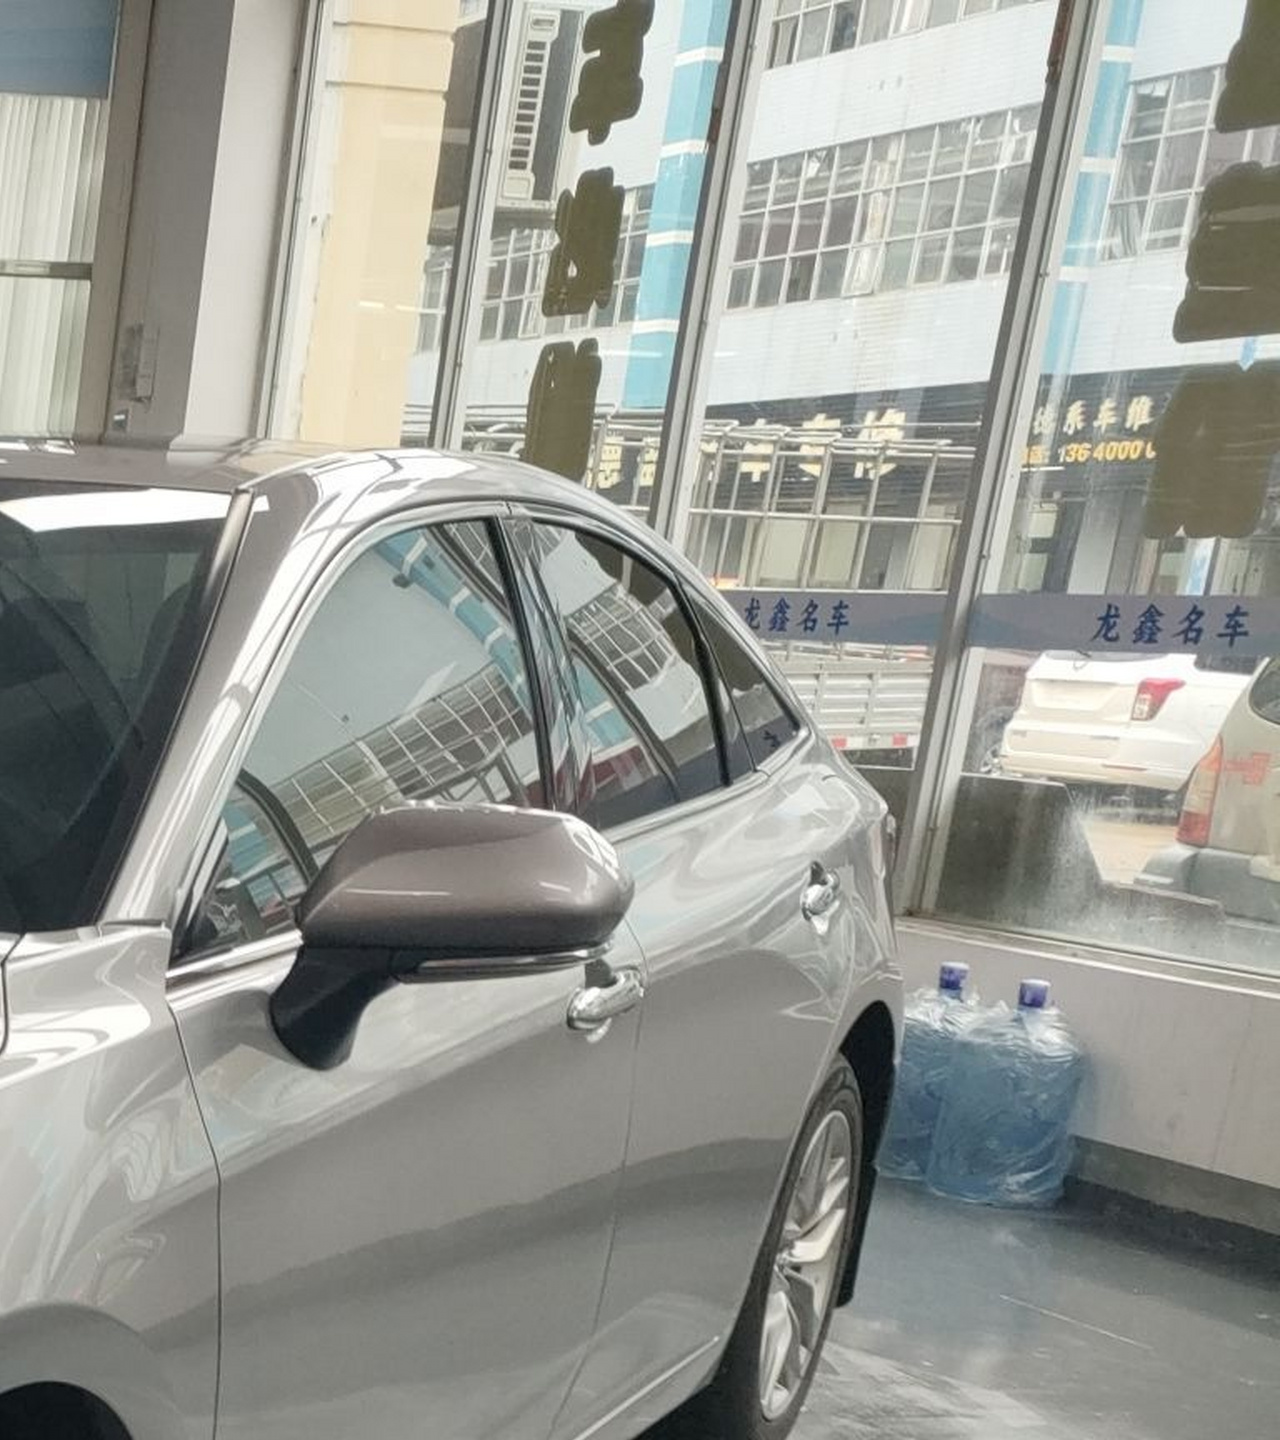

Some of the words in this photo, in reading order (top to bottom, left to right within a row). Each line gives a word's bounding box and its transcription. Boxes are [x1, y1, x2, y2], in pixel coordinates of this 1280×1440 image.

[744, 597, 849, 635] 龙鑫名车
[1091, 603, 1249, 648] 龙鑫名车
